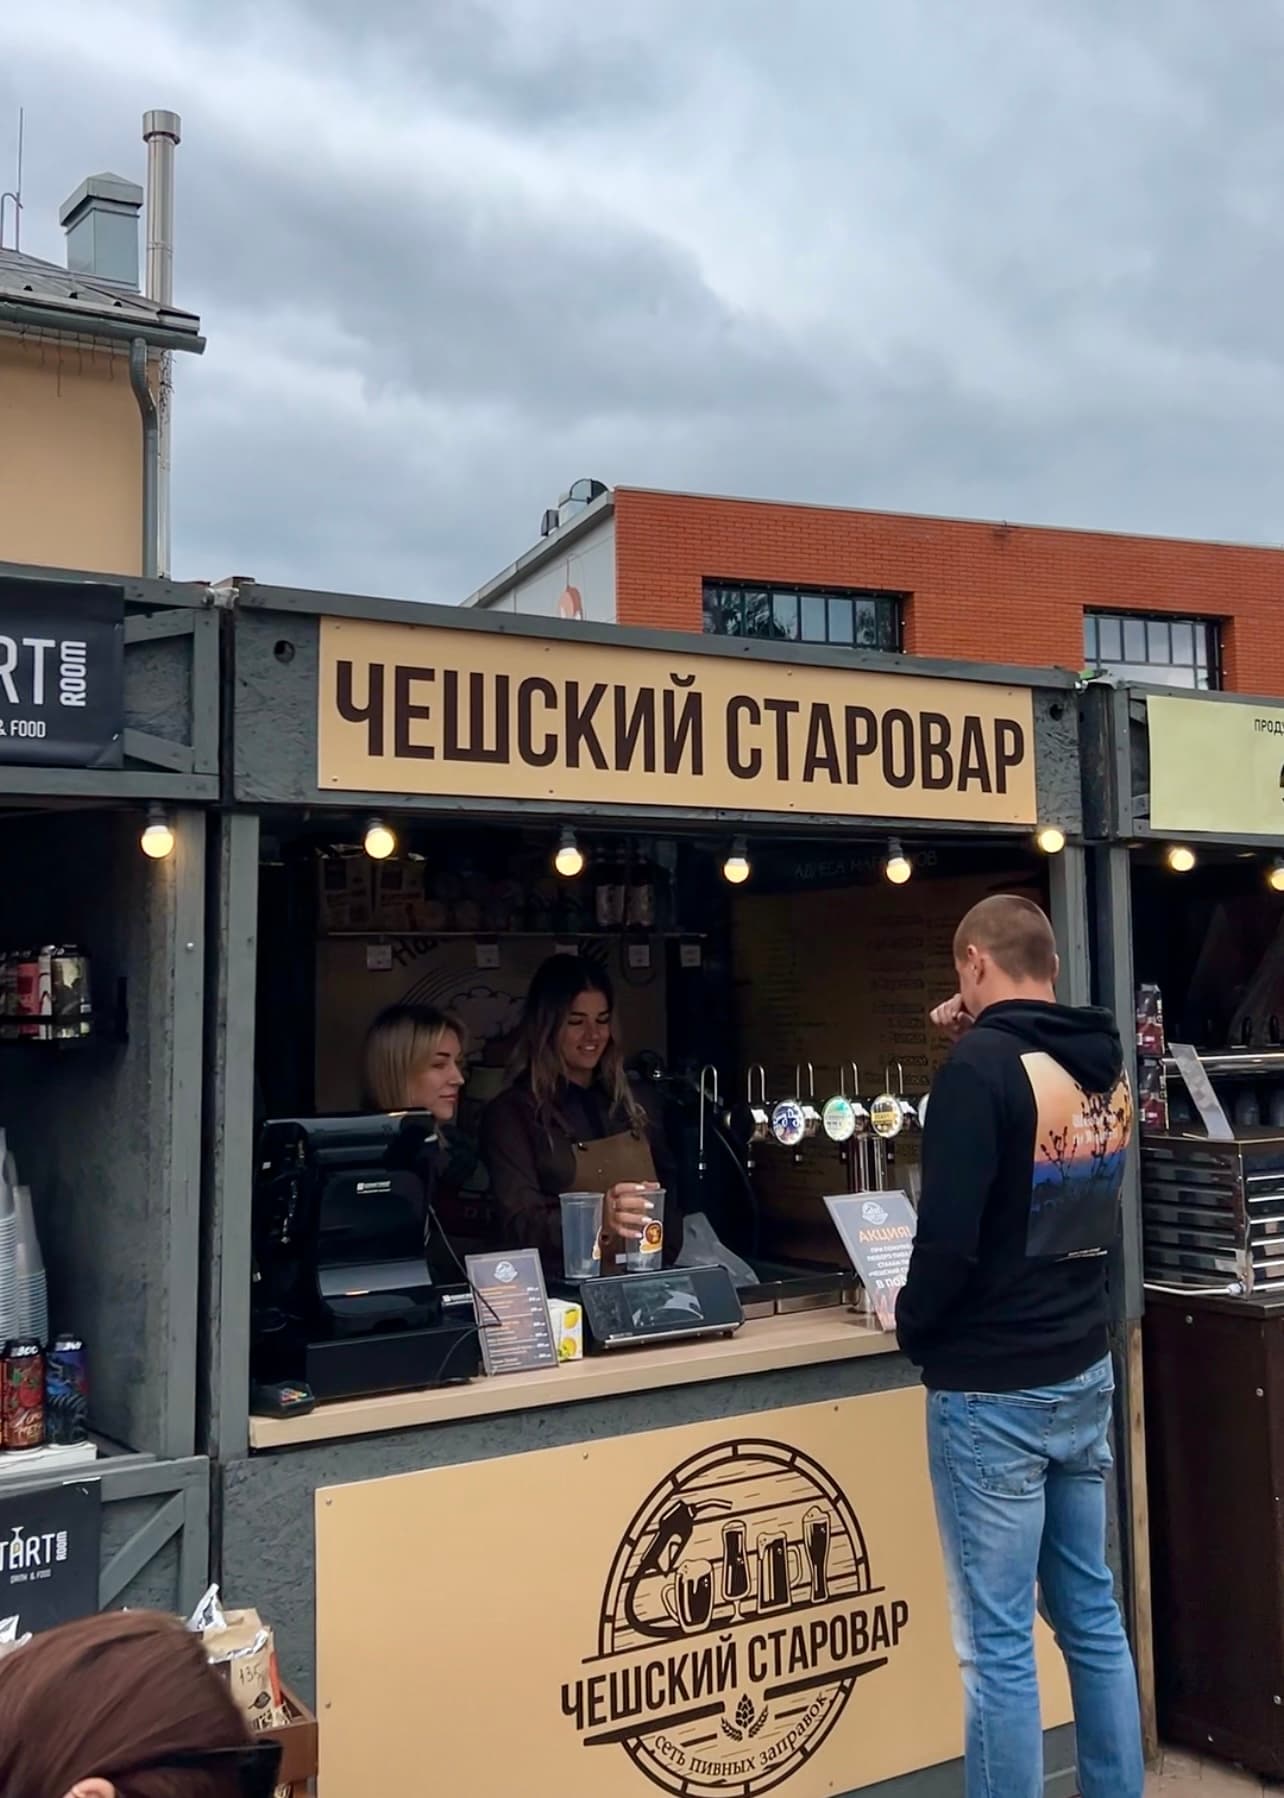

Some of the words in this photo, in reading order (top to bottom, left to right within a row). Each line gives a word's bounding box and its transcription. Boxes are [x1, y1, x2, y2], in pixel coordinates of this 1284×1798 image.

[10, 719, 46, 738] FOOD
[336, 659, 704, 776] ЧЕШСКИЙ
[725, 695, 1025, 794] СТАРОВАР
[561, 1634, 738, 1731] ЧЕШСКИЙ
[748, 1599, 909, 1683] СТАРОВАР
[654, 1735, 686, 1766] сеть
[689, 1756, 758, 1776] пивных
[759, 1693, 828, 1766] заправок
